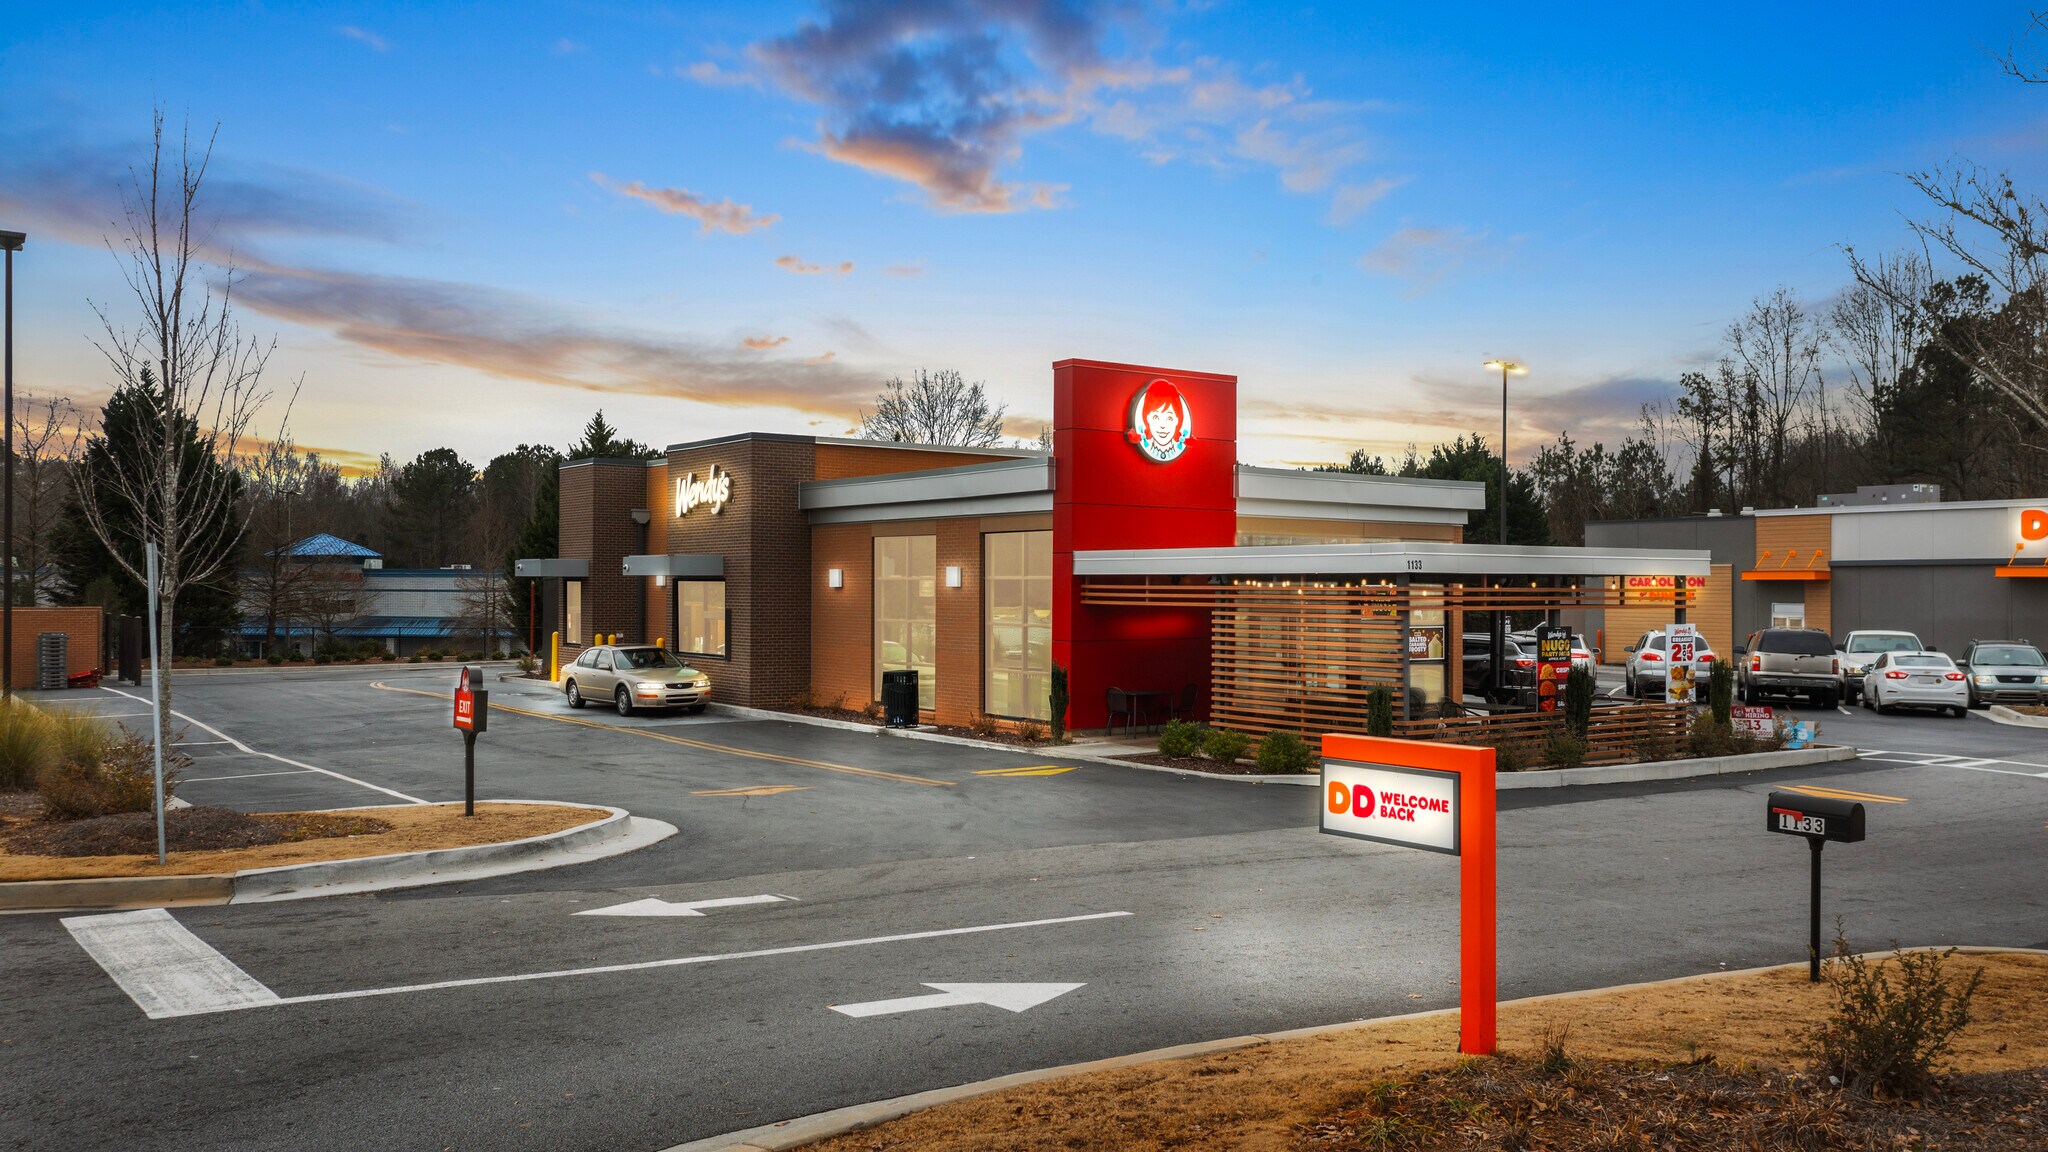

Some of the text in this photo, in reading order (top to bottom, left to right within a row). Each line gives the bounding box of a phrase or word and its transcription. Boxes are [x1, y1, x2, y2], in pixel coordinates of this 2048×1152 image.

[676, 464, 730, 518] Wendy's
[1407, 559, 1422, 570] 1133
[1541, 639, 1571, 651] NUGG
[1671, 643, 1682, 661] 2
[459, 700, 470, 714] EXIT
[1328, 781, 1376, 818] DD
[1380, 791, 1449, 813] WELCOME
[1380, 805, 1415, 822] BACK
[1782, 814, 1823, 833] 1133
